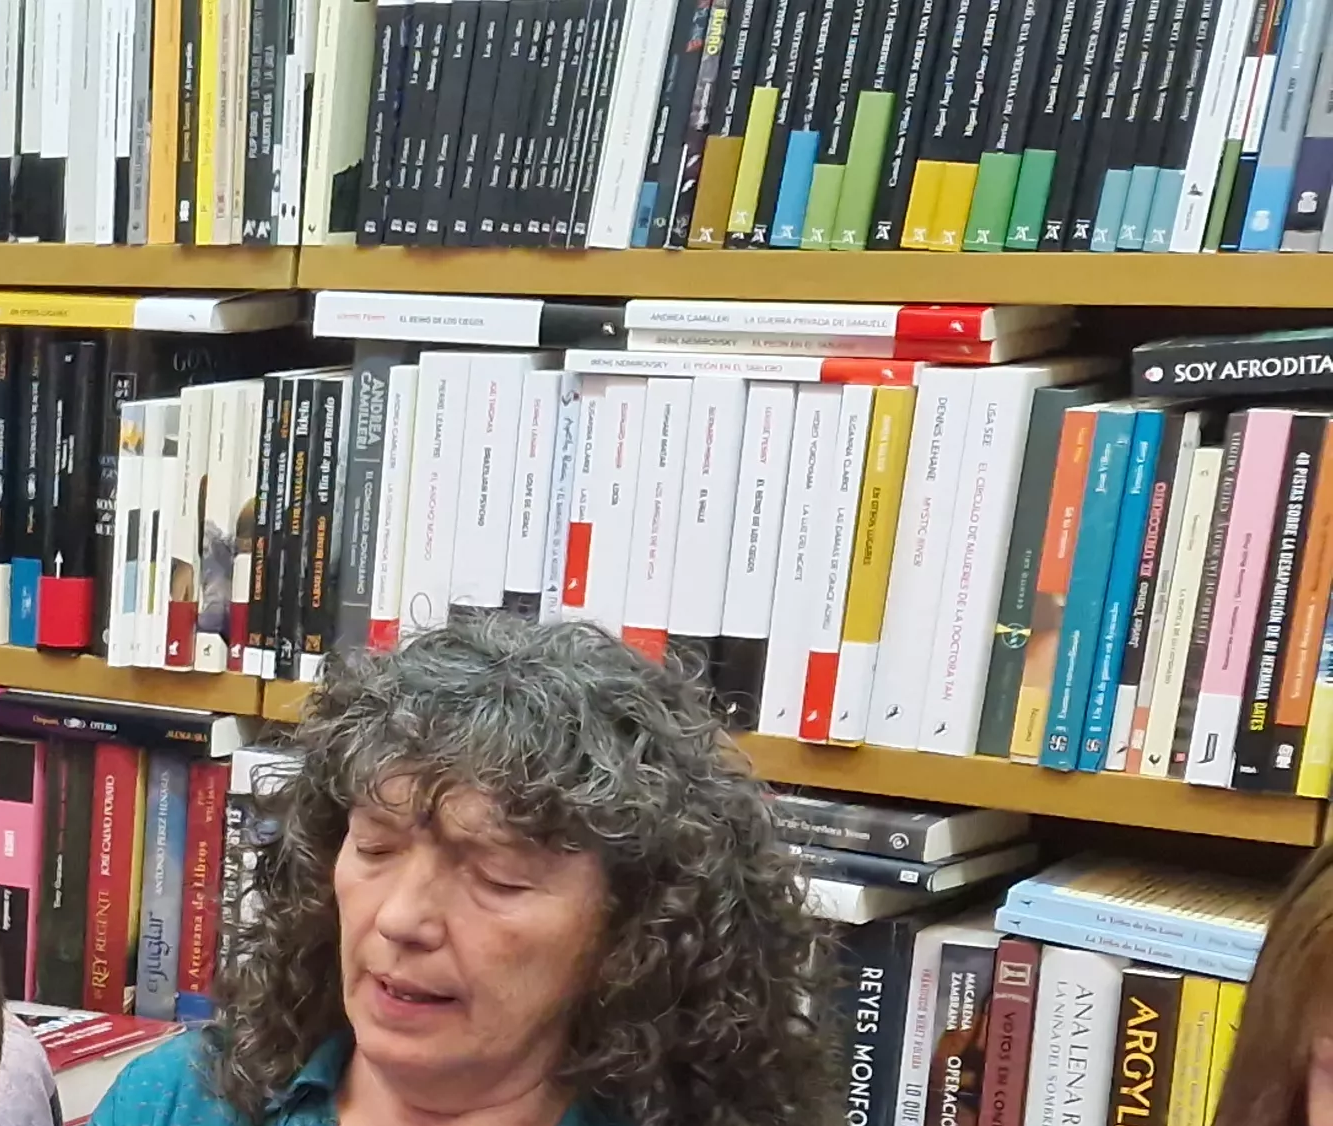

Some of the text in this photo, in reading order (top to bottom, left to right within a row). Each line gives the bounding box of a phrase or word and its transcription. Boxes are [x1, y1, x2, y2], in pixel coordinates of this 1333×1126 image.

[650, 313, 684, 321] ANDREA
[687, 314, 729, 323] CAMILLERI
[744, 315, 754, 324] LA
[757, 316, 791, 325] GUERRA
[794, 317, 829, 326] PRIVADA
[832, 318, 844, 326] DE
[1172, 354, 1333, 382] SOY AFRODITA
[322, 396, 336, 438] mundo
[354, 371, 374, 449] CAMILLERI
[366, 377, 386, 445] ANDREA
[984, 402, 998, 425] LISA
[322, 440, 332, 457] un
[981, 427, 994, 447] SEE
[320, 458, 331, 472] de
[977, 462, 989, 474] EL
[911, 395, 948, 567] DENNIS LEHANE MYSTIC RIVER
[1288, 466, 1307, 501] PISTAS
[317, 491, 328, 502] el
[966, 525, 978, 541] DE
[1141, 481, 1169, 559] UNICORNIO
[1283, 502, 1301, 536] SOBRE
[1280, 537, 1296, 550] LA
[958, 542, 976, 590] MUJERES
[1139, 559, 1153, 577] EL
[956, 592, 968, 607] DE
[1268, 551, 1294, 623] DESAPARICIÓN
[953, 608, 965, 622] LA
[1264, 639, 1279, 652] MI
[1266, 624, 1281, 638] DE
[944, 624, 962, 678] DOCTORA
[940, 679, 953, 701] TAN
[1254, 654, 1274, 701] HERMANA
[98, 774, 115, 875] JOSÉ CALVO POYATO
[153, 847, 166, 895] ANTONIO
[188, 840, 208, 977] Artesana de Libros
[90, 955, 109, 988] REY
[855, 966, 884, 1033] REYES
[944, 971, 963, 1030] ZAMBRANA
[959, 972, 977, 1030] MACARENA
[1054, 981, 1067, 998] LA
[1071, 984, 1094, 1036] ANA
[997, 1011, 1017, 1060] VOTOS
[1047, 1043, 1060, 1067] DEL
[906, 1082, 922, 1097] LO
[995, 1065, 1009, 1085] EN
[1063, 1044, 1088, 1105] LENA
[902, 1100, 920, 1121] QUE
